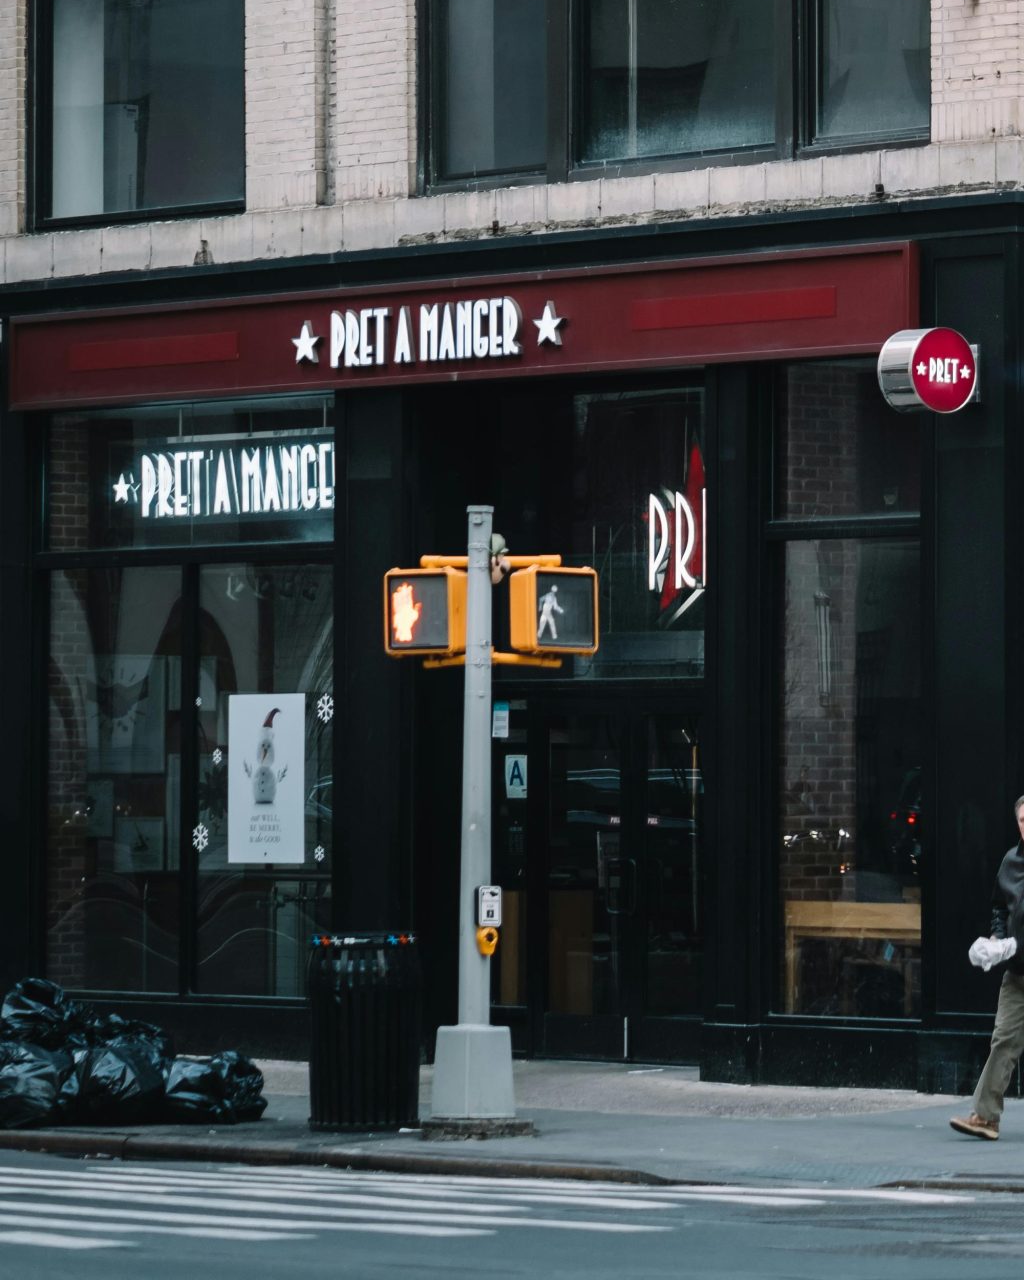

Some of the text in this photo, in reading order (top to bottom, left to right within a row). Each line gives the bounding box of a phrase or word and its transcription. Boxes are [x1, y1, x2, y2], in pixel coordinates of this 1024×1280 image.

[330, 296, 522, 368] PRET A MANGER
[929, 356, 960, 385] PRET
[141, 451, 205, 518] PRET
[213, 449, 232, 514] A
[509, 760, 525, 786] A
